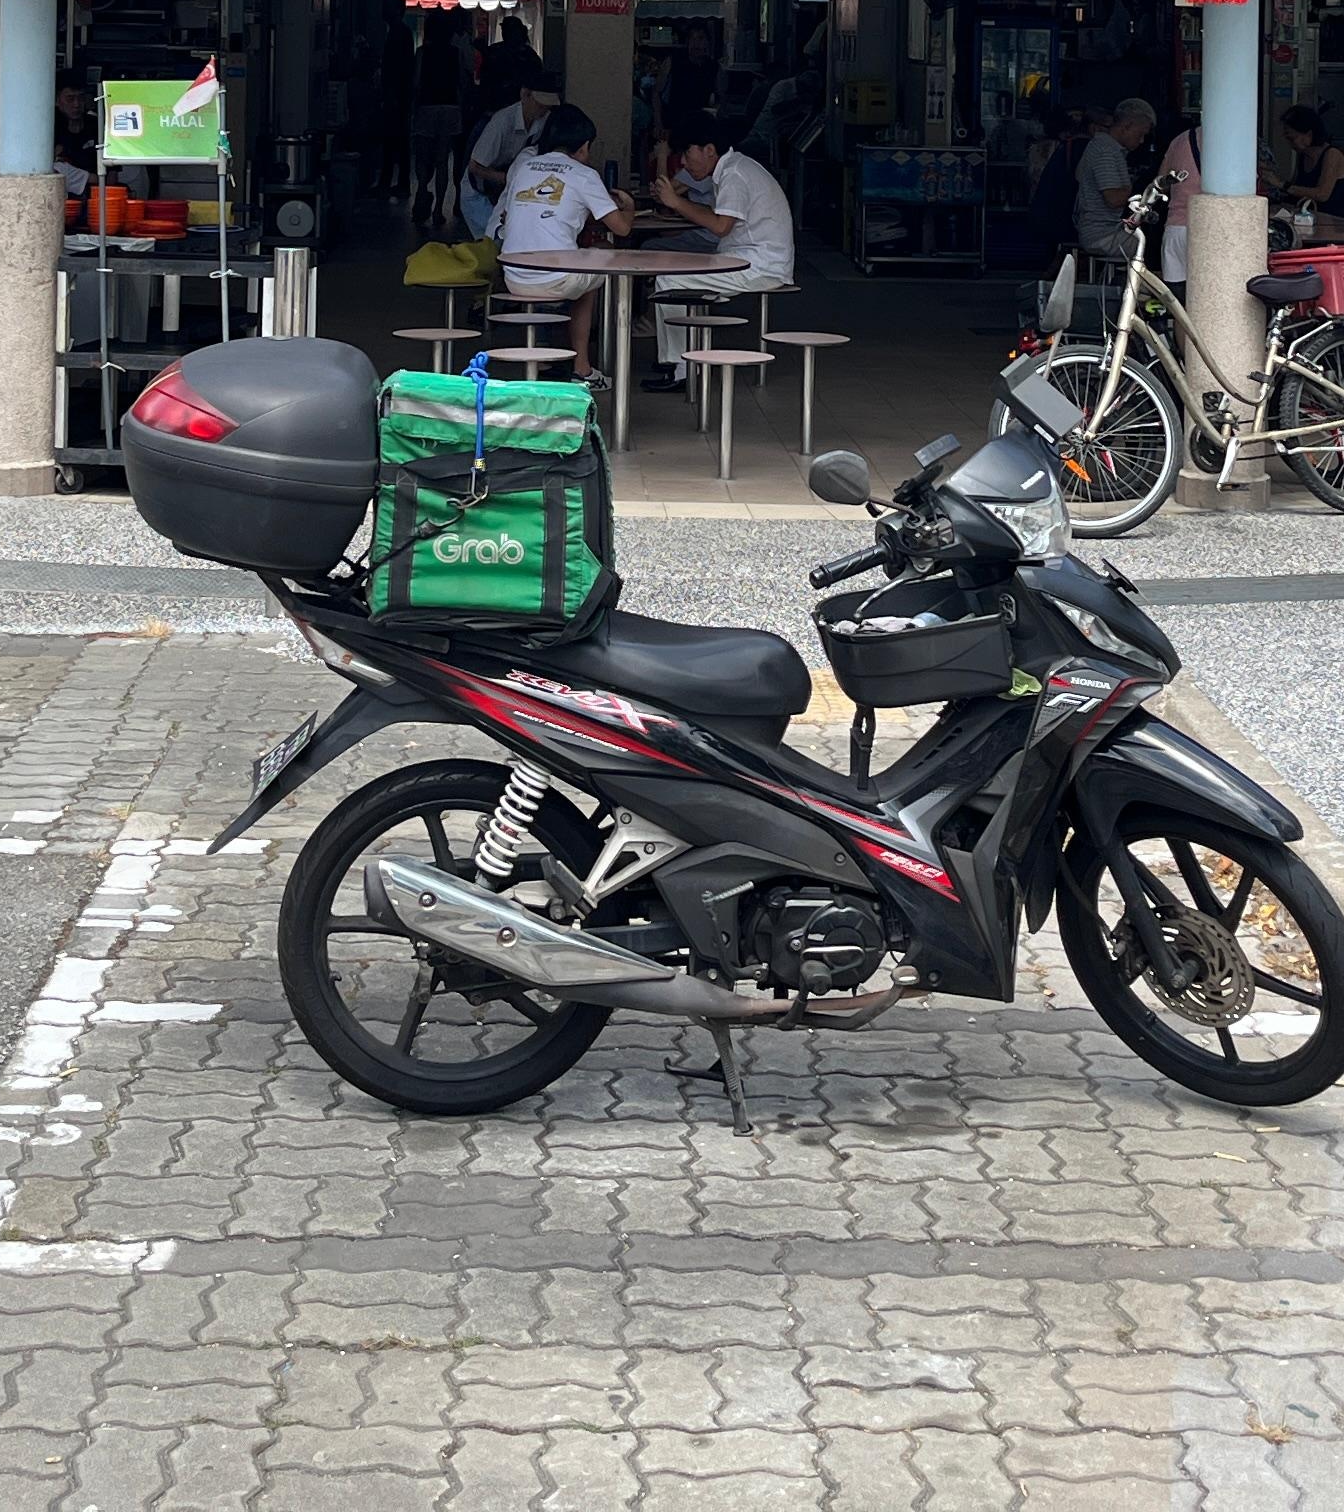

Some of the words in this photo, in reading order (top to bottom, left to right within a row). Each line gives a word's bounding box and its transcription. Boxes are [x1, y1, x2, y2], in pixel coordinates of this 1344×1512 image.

[160, 114, 206, 128] HALAL
[432, 531, 525, 566] Grab
[1070, 676, 1112, 690] HONDA
[506, 668, 607, 707] REVO
[581, 690, 679, 735] X
